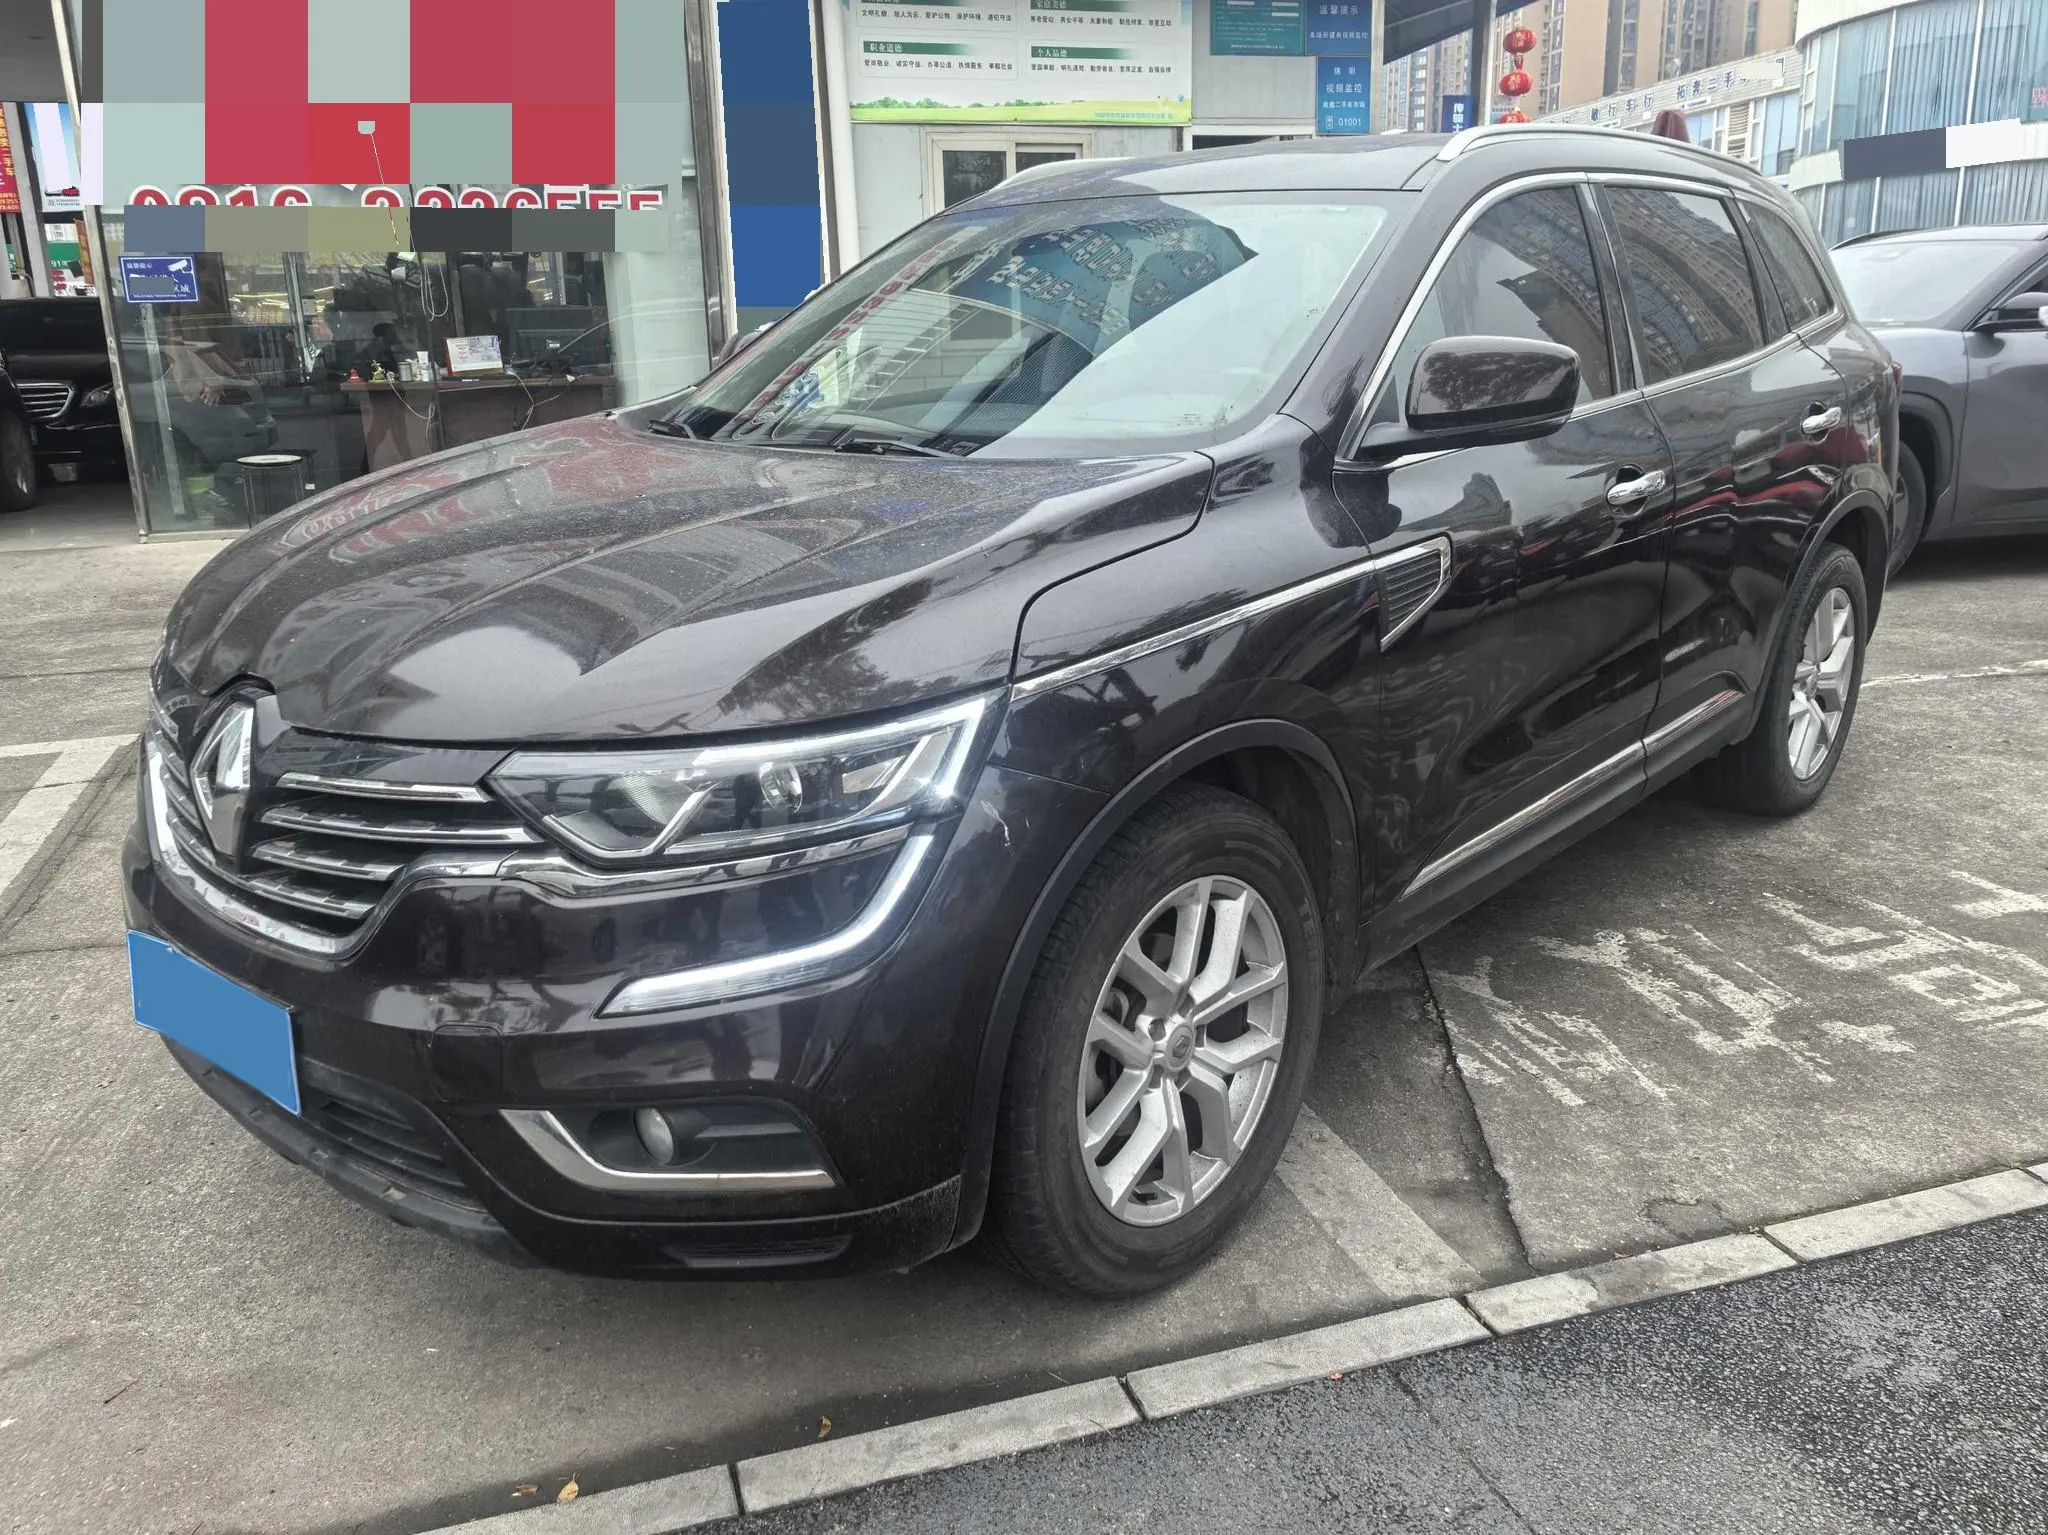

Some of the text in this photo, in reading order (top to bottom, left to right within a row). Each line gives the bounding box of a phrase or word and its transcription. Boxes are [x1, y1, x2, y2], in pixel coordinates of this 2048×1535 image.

[1319, 4, 1360, 16] 温馨提示
[869, 42, 903, 53] 职业道德
[1036, 48, 1067, 58] 个人品德
[1326, 83, 1363, 94] 视频监控
[1338, 118, 1362, 127] 01001
